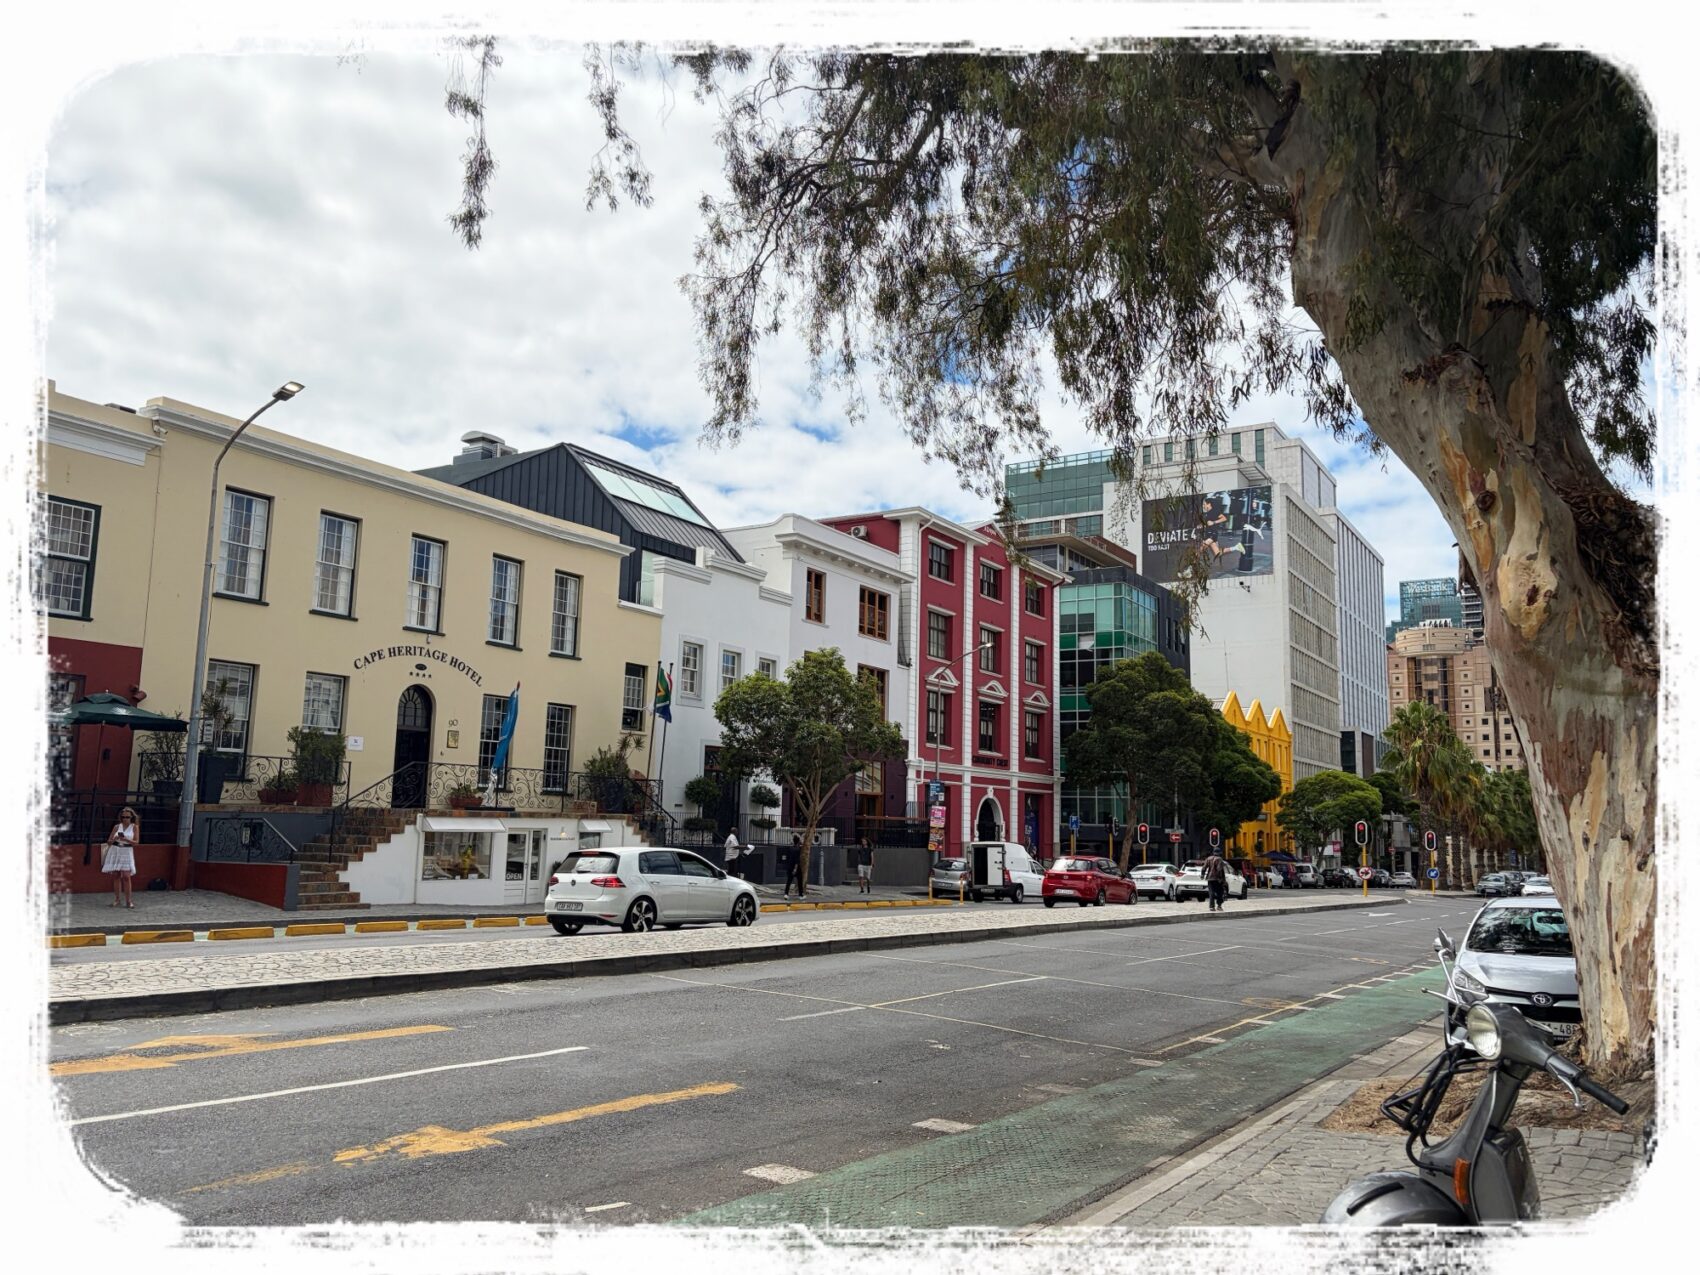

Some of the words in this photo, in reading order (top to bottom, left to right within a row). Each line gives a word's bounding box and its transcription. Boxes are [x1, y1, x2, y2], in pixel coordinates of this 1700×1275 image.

[1191, 528, 1197, 539] 4
[354, 648, 386, 670] CAPE
[388, 645, 448, 663] HERITAGE
[449, 656, 483, 687] HOTEL
[506, 872, 523, 881] OPEN
